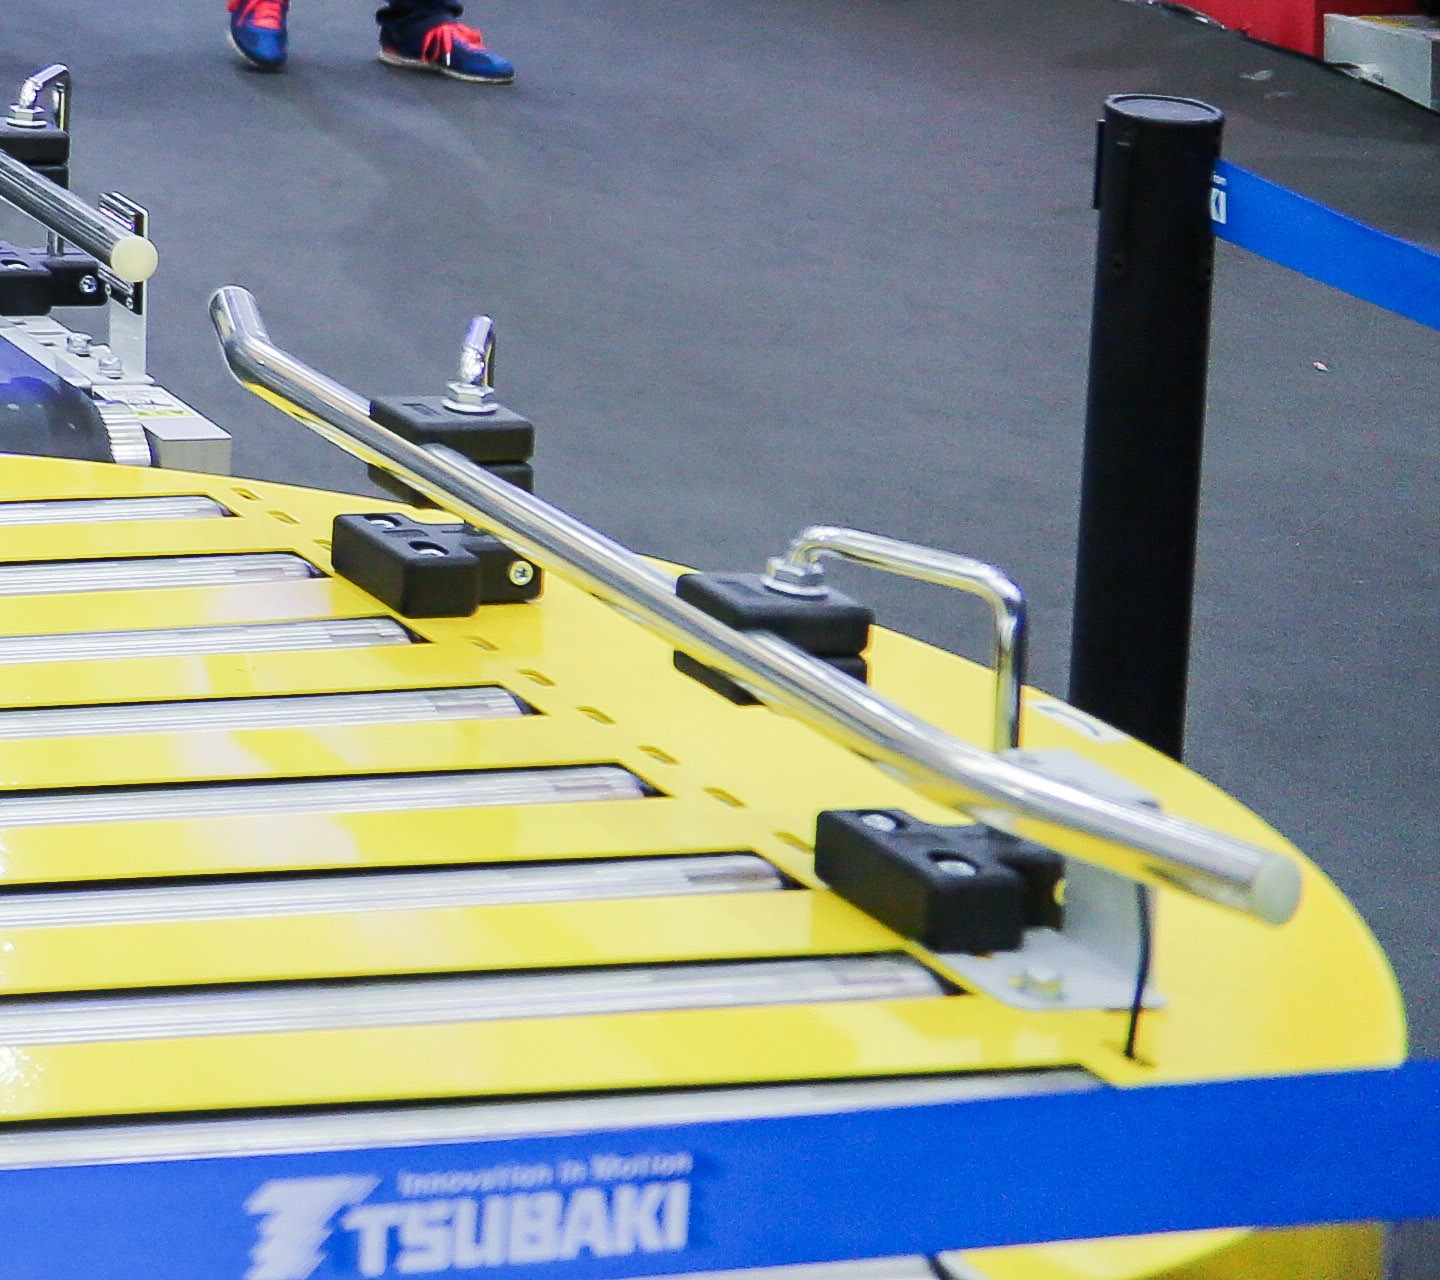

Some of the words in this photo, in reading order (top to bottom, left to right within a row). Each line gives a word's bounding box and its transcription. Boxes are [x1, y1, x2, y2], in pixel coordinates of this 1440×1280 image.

[397, 1161, 554, 1197] Innovation
[589, 1151, 693, 1180] Motion
[344, 1180, 690, 1278] TSUBAKI
